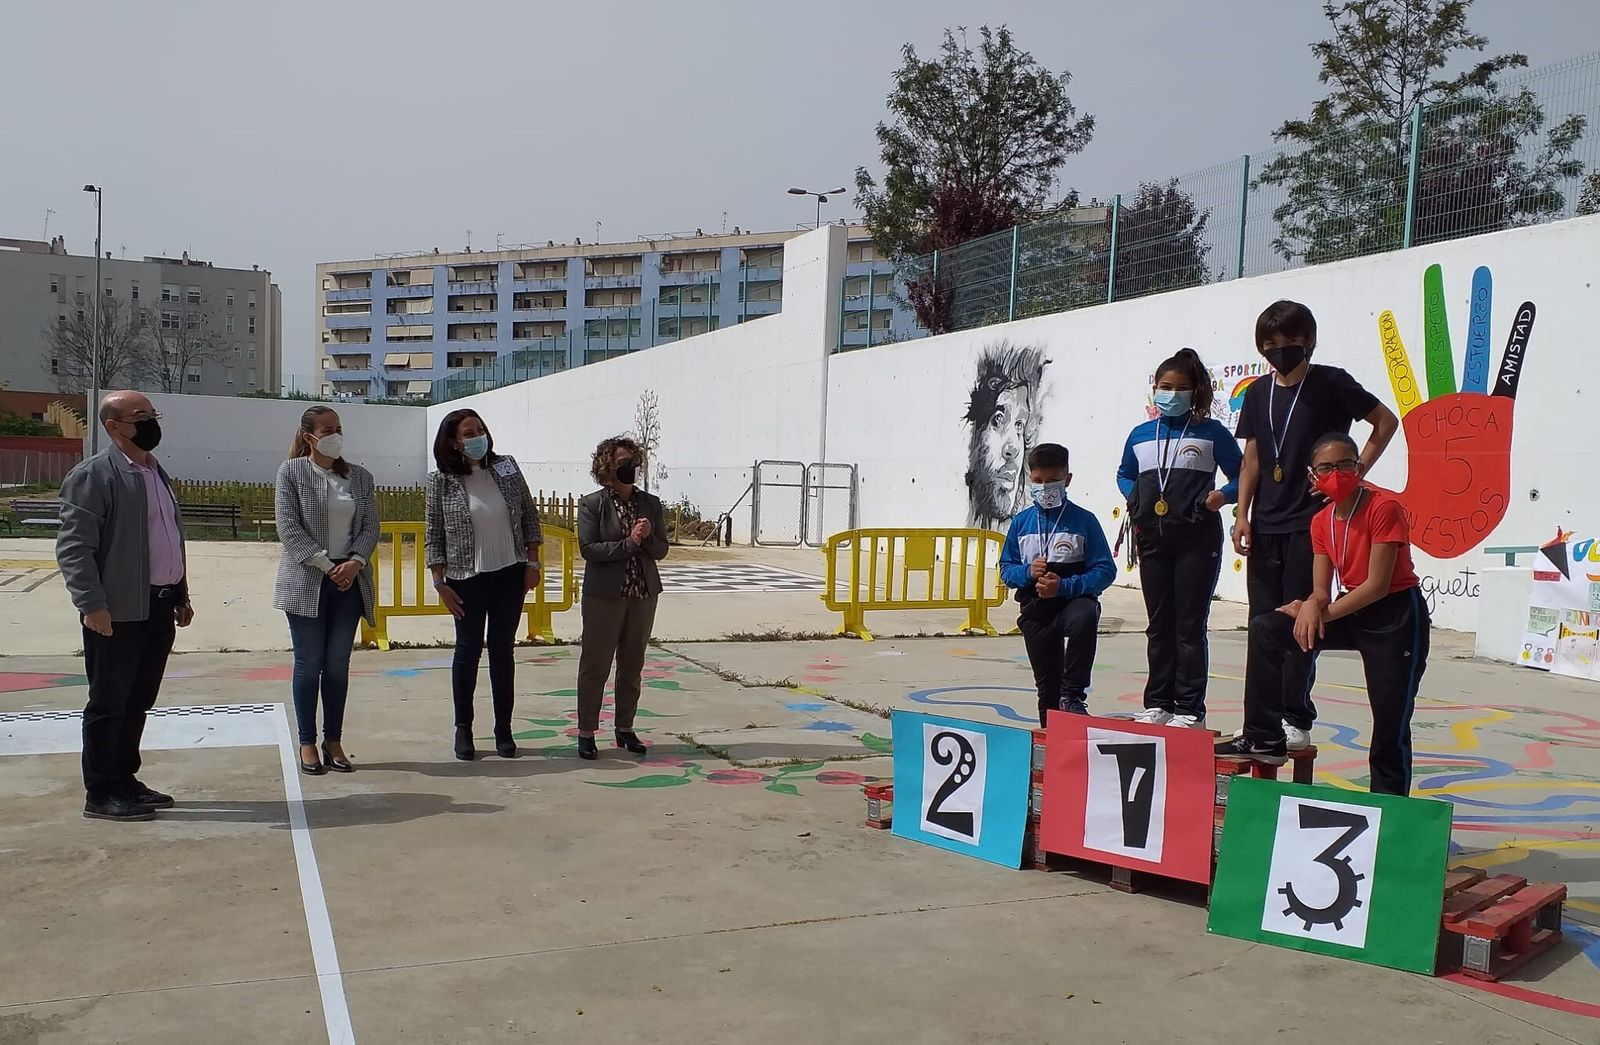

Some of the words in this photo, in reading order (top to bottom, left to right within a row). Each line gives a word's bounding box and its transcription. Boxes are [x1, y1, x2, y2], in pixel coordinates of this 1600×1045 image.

[1224, 362, 1271, 378] SPORTIV
[1429, 292, 1448, 386] RESPETO
[1467, 287, 1489, 385] ESFUERZO
[1501, 309, 1532, 386] AMISTAD
[1417, 406, 1499, 438] CHOCA
[1443, 436, 1475, 495] 5
[1422, 488, 1504, 552] ESTOS
[926, 731, 975, 837] 2
[1097, 742, 1156, 848] 1
[1278, 804, 1369, 932] 3
